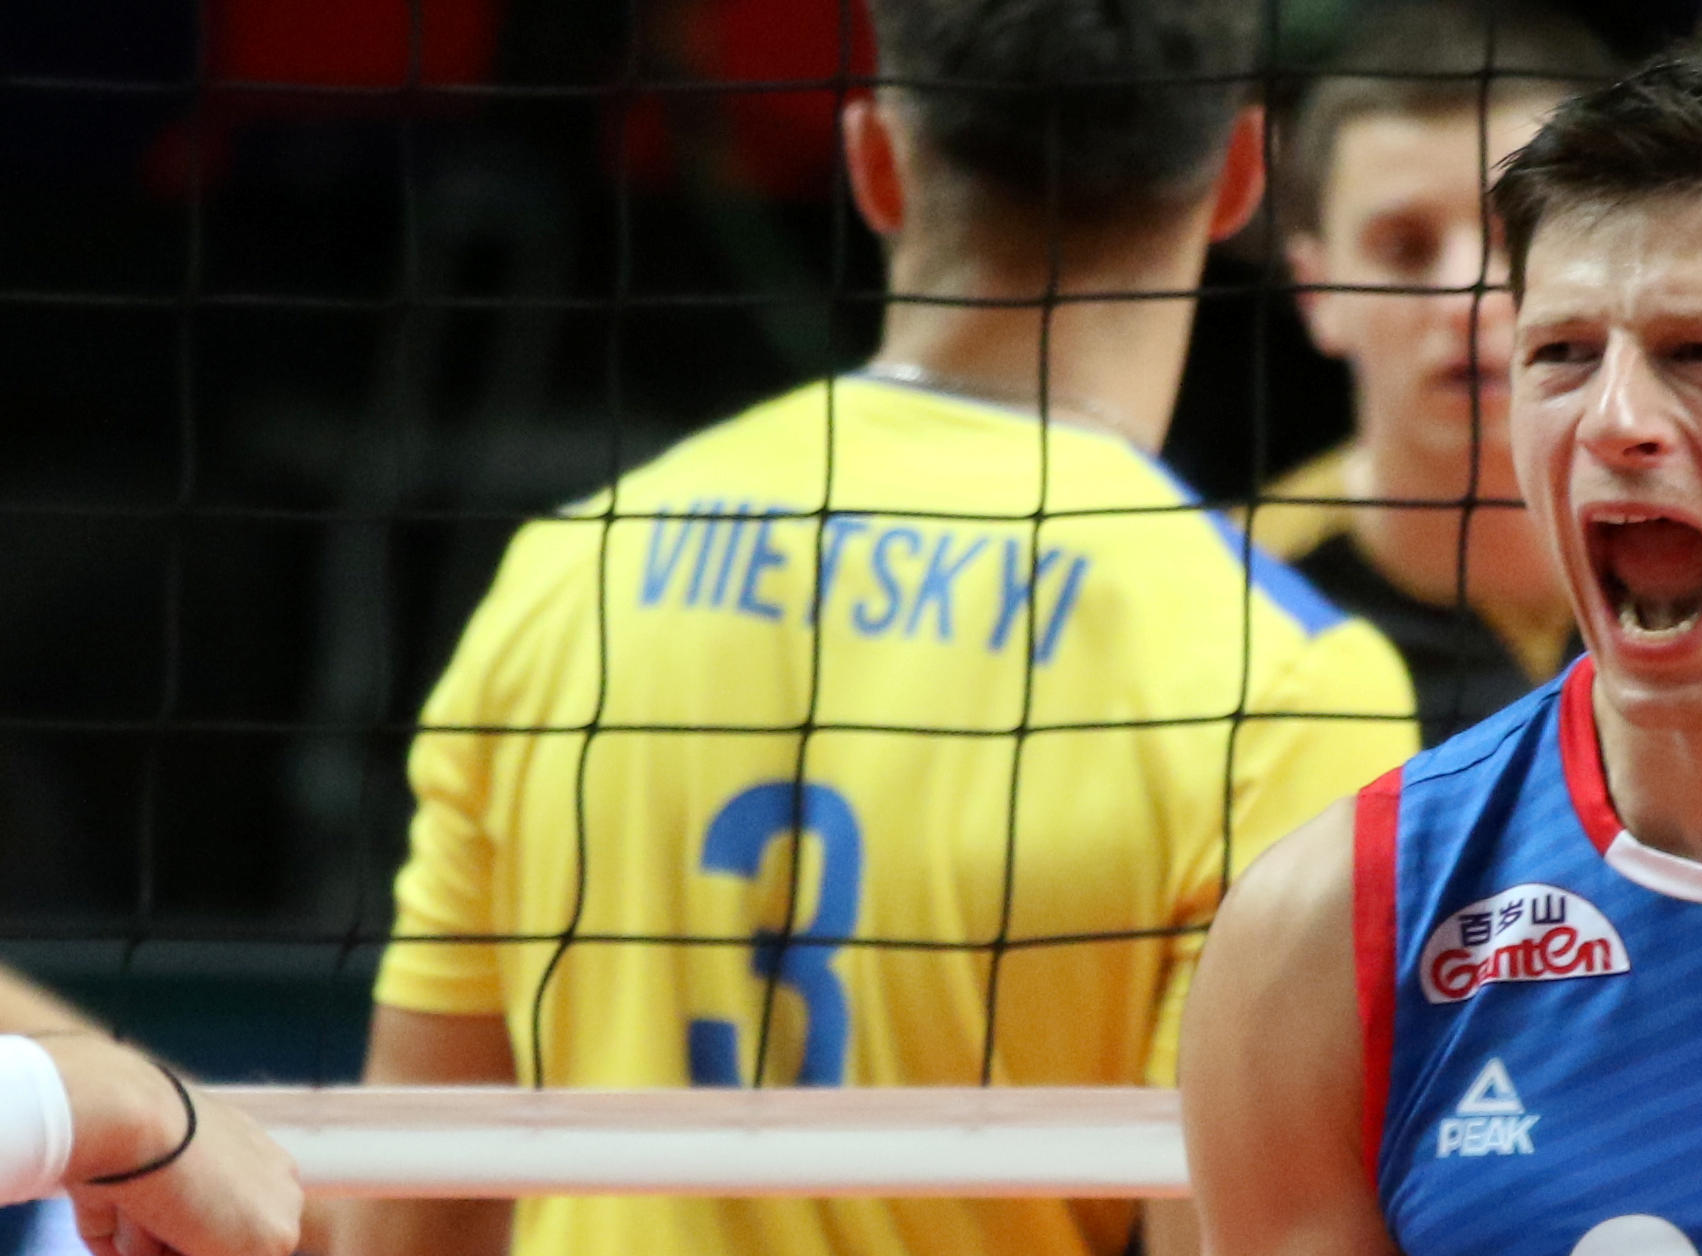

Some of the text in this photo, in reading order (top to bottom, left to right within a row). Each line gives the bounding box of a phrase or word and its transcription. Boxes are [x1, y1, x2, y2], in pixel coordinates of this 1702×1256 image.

[636, 494, 1092, 667] VIIETSKYI
[686, 779, 864, 1088] 3
[1458, 894, 1567, 947] 百岁山
[1436, 1114, 1542, 1159] PEAK
